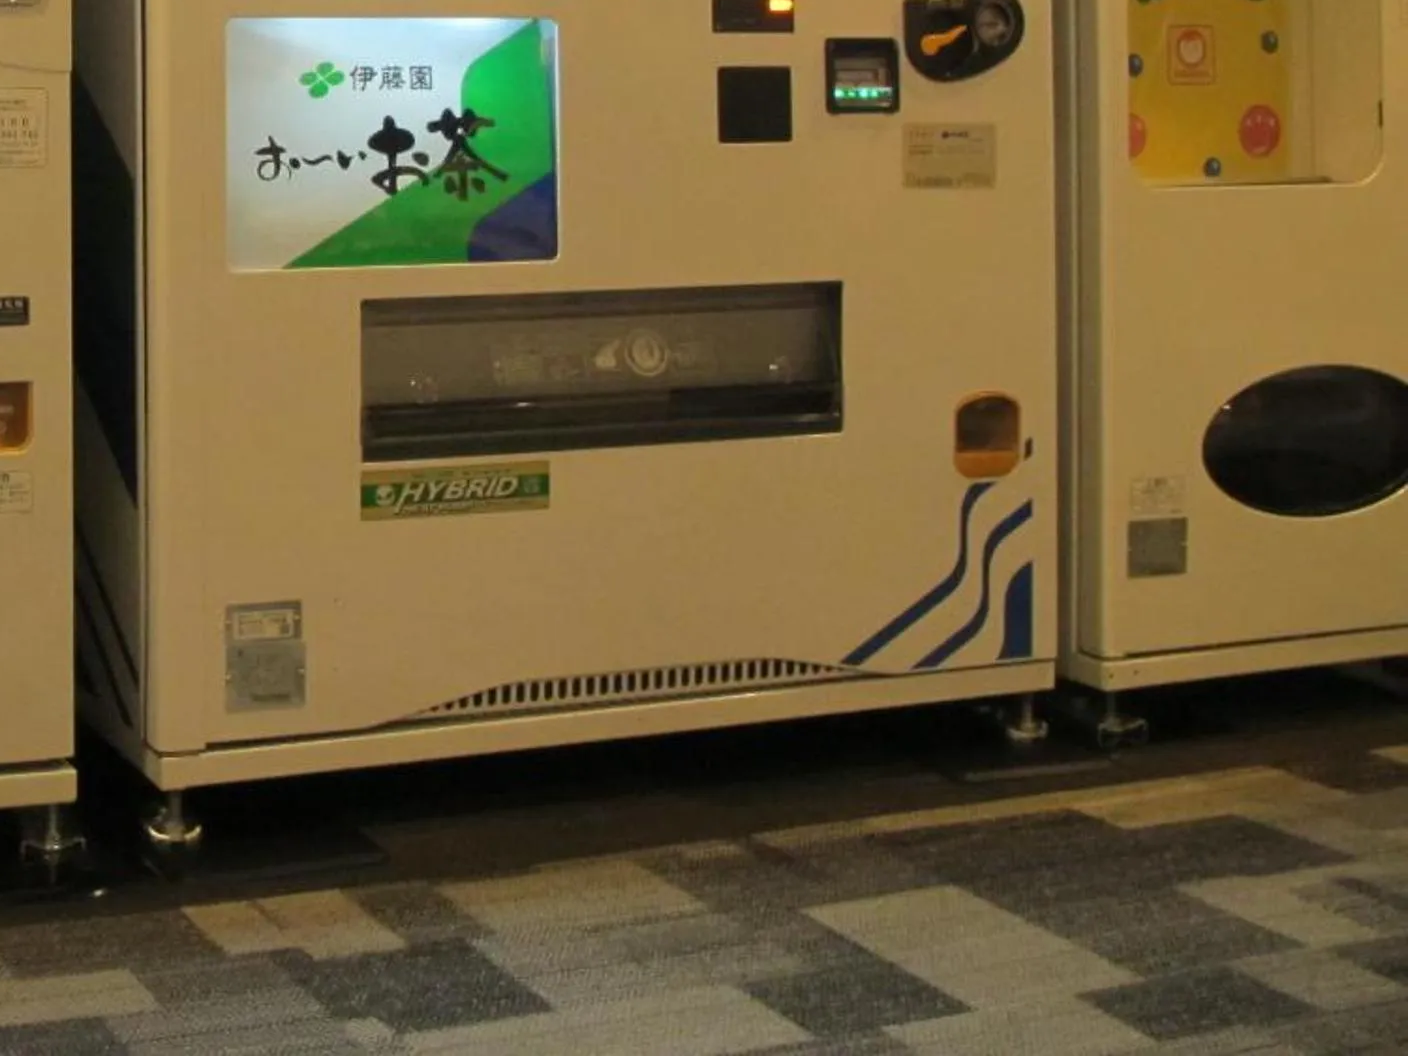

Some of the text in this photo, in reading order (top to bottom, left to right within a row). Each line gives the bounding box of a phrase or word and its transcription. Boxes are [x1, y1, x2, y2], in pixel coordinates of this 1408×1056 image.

[349, 64, 434, 92] 伊藤園
[394, 474, 519, 507] HYBRID
